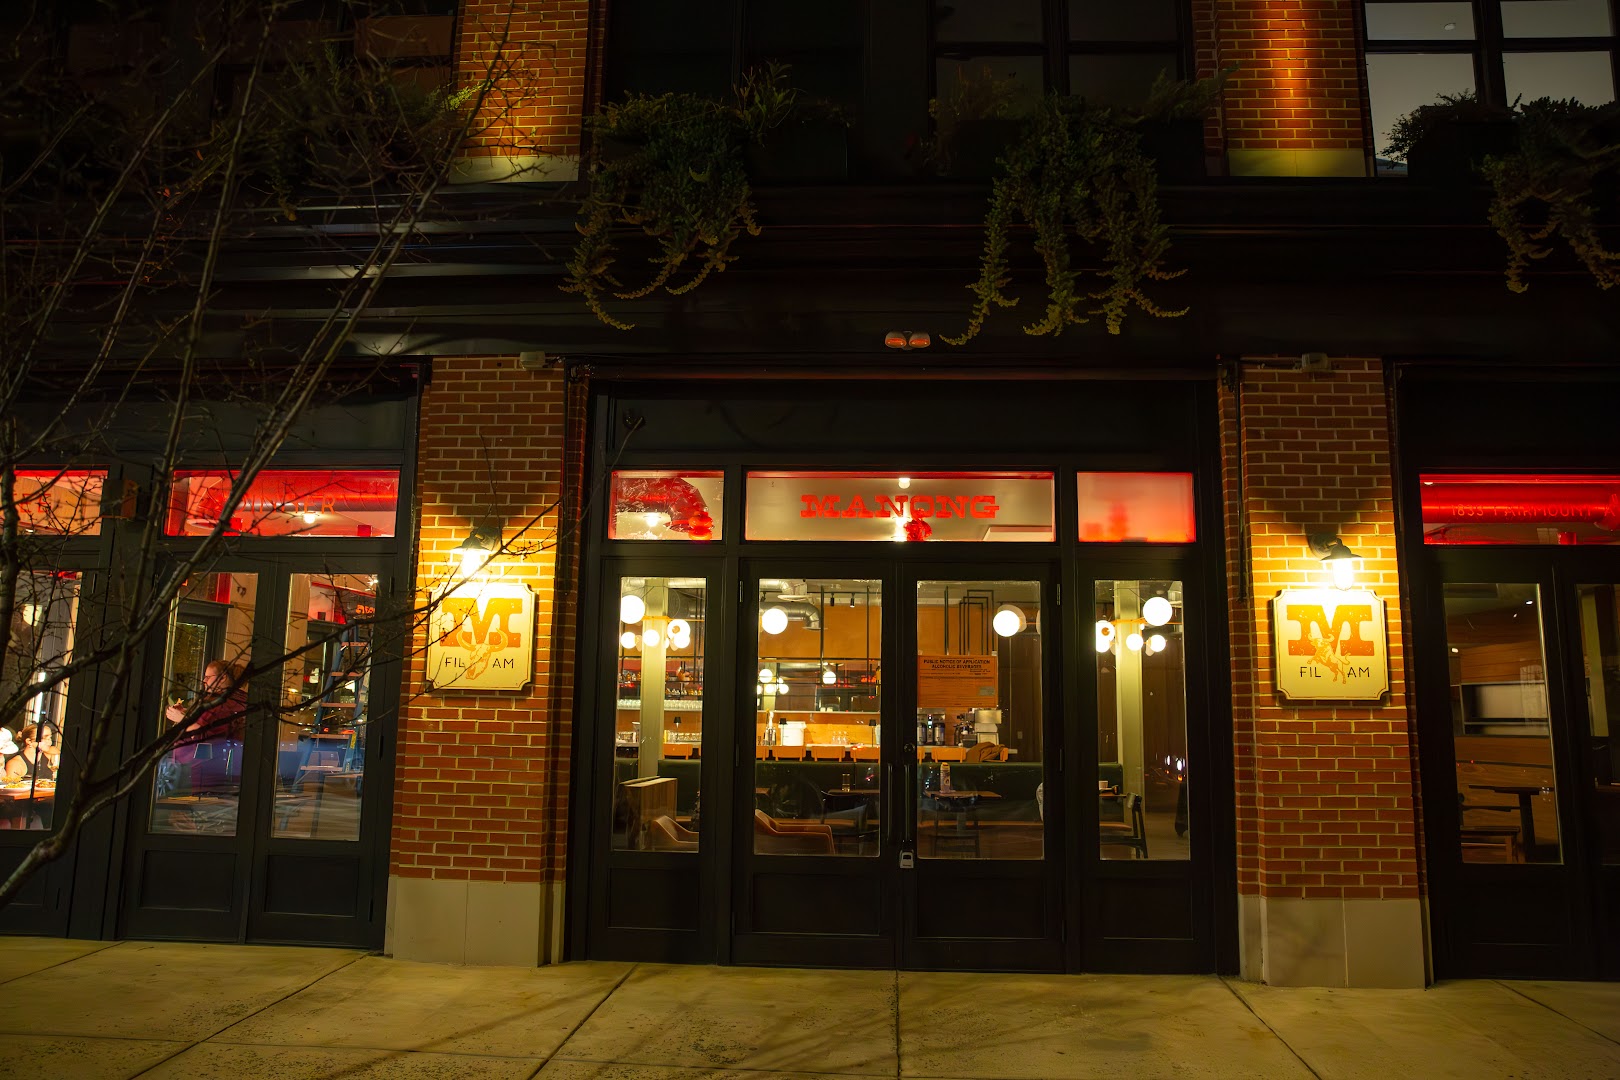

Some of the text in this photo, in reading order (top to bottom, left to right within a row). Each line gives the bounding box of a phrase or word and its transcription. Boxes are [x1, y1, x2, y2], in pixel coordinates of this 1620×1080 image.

[800, 495, 999, 519] MANONG
[440, 598, 523, 648] M
[1286, 605, 1375, 656] M
[444, 657, 515, 669] FIL AM
[1299, 666, 1370, 678] FIL AM
